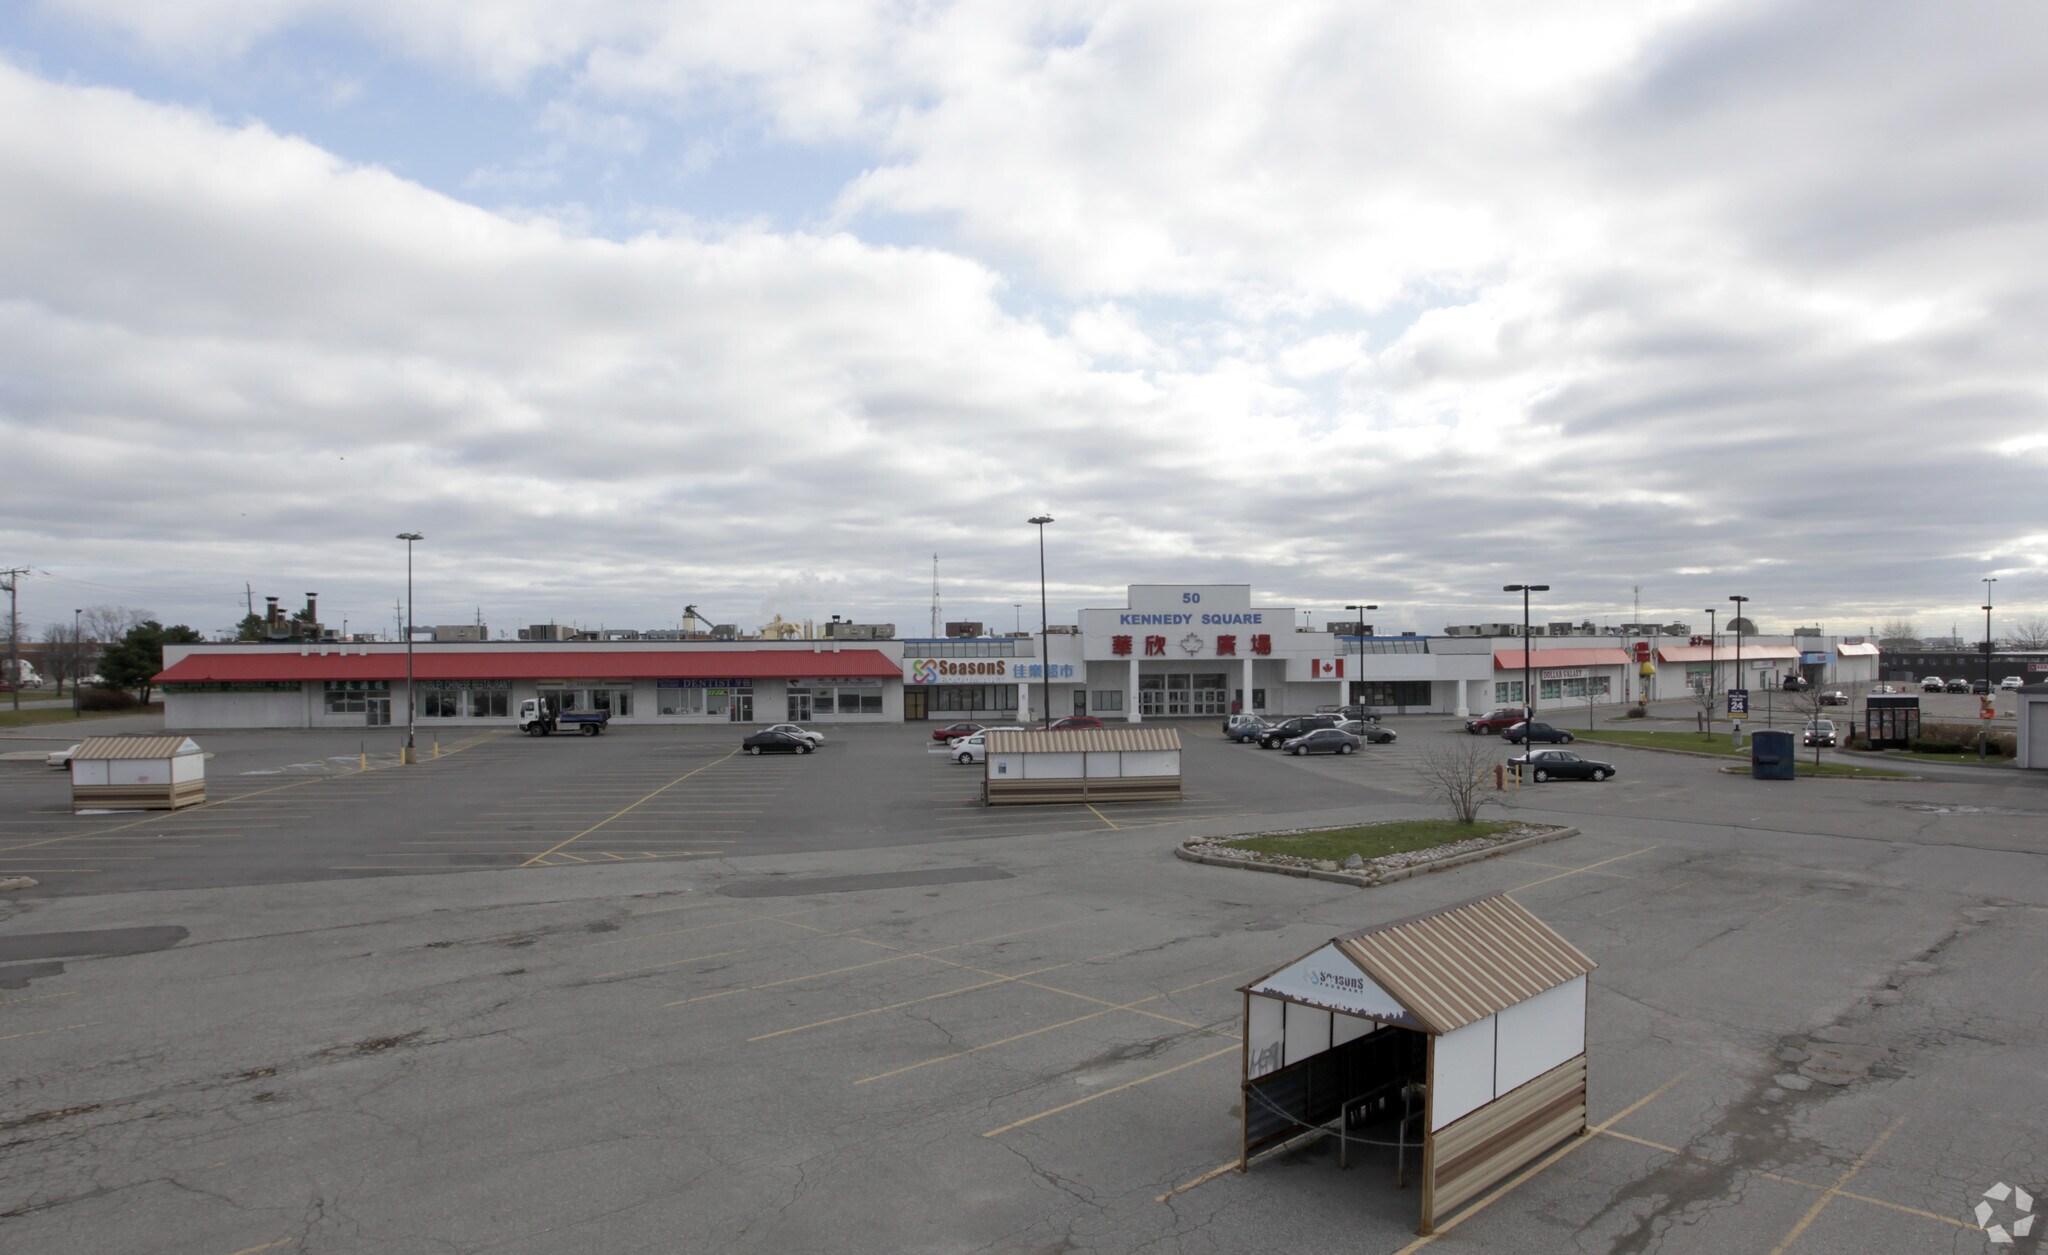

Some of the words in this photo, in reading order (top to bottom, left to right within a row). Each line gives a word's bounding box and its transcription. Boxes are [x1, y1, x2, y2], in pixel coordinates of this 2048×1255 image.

[1182, 593, 1200, 604] 50
[1120, 614, 1192, 625] KENNEDY
[1201, 614, 1262, 625] SQUARE
[444, 680, 471, 689] CHINESE
[472, 680, 512, 689] RESTAURANT
[683, 679, 731, 687] DENTIST
[1731, 701, 1743, 710] 24
